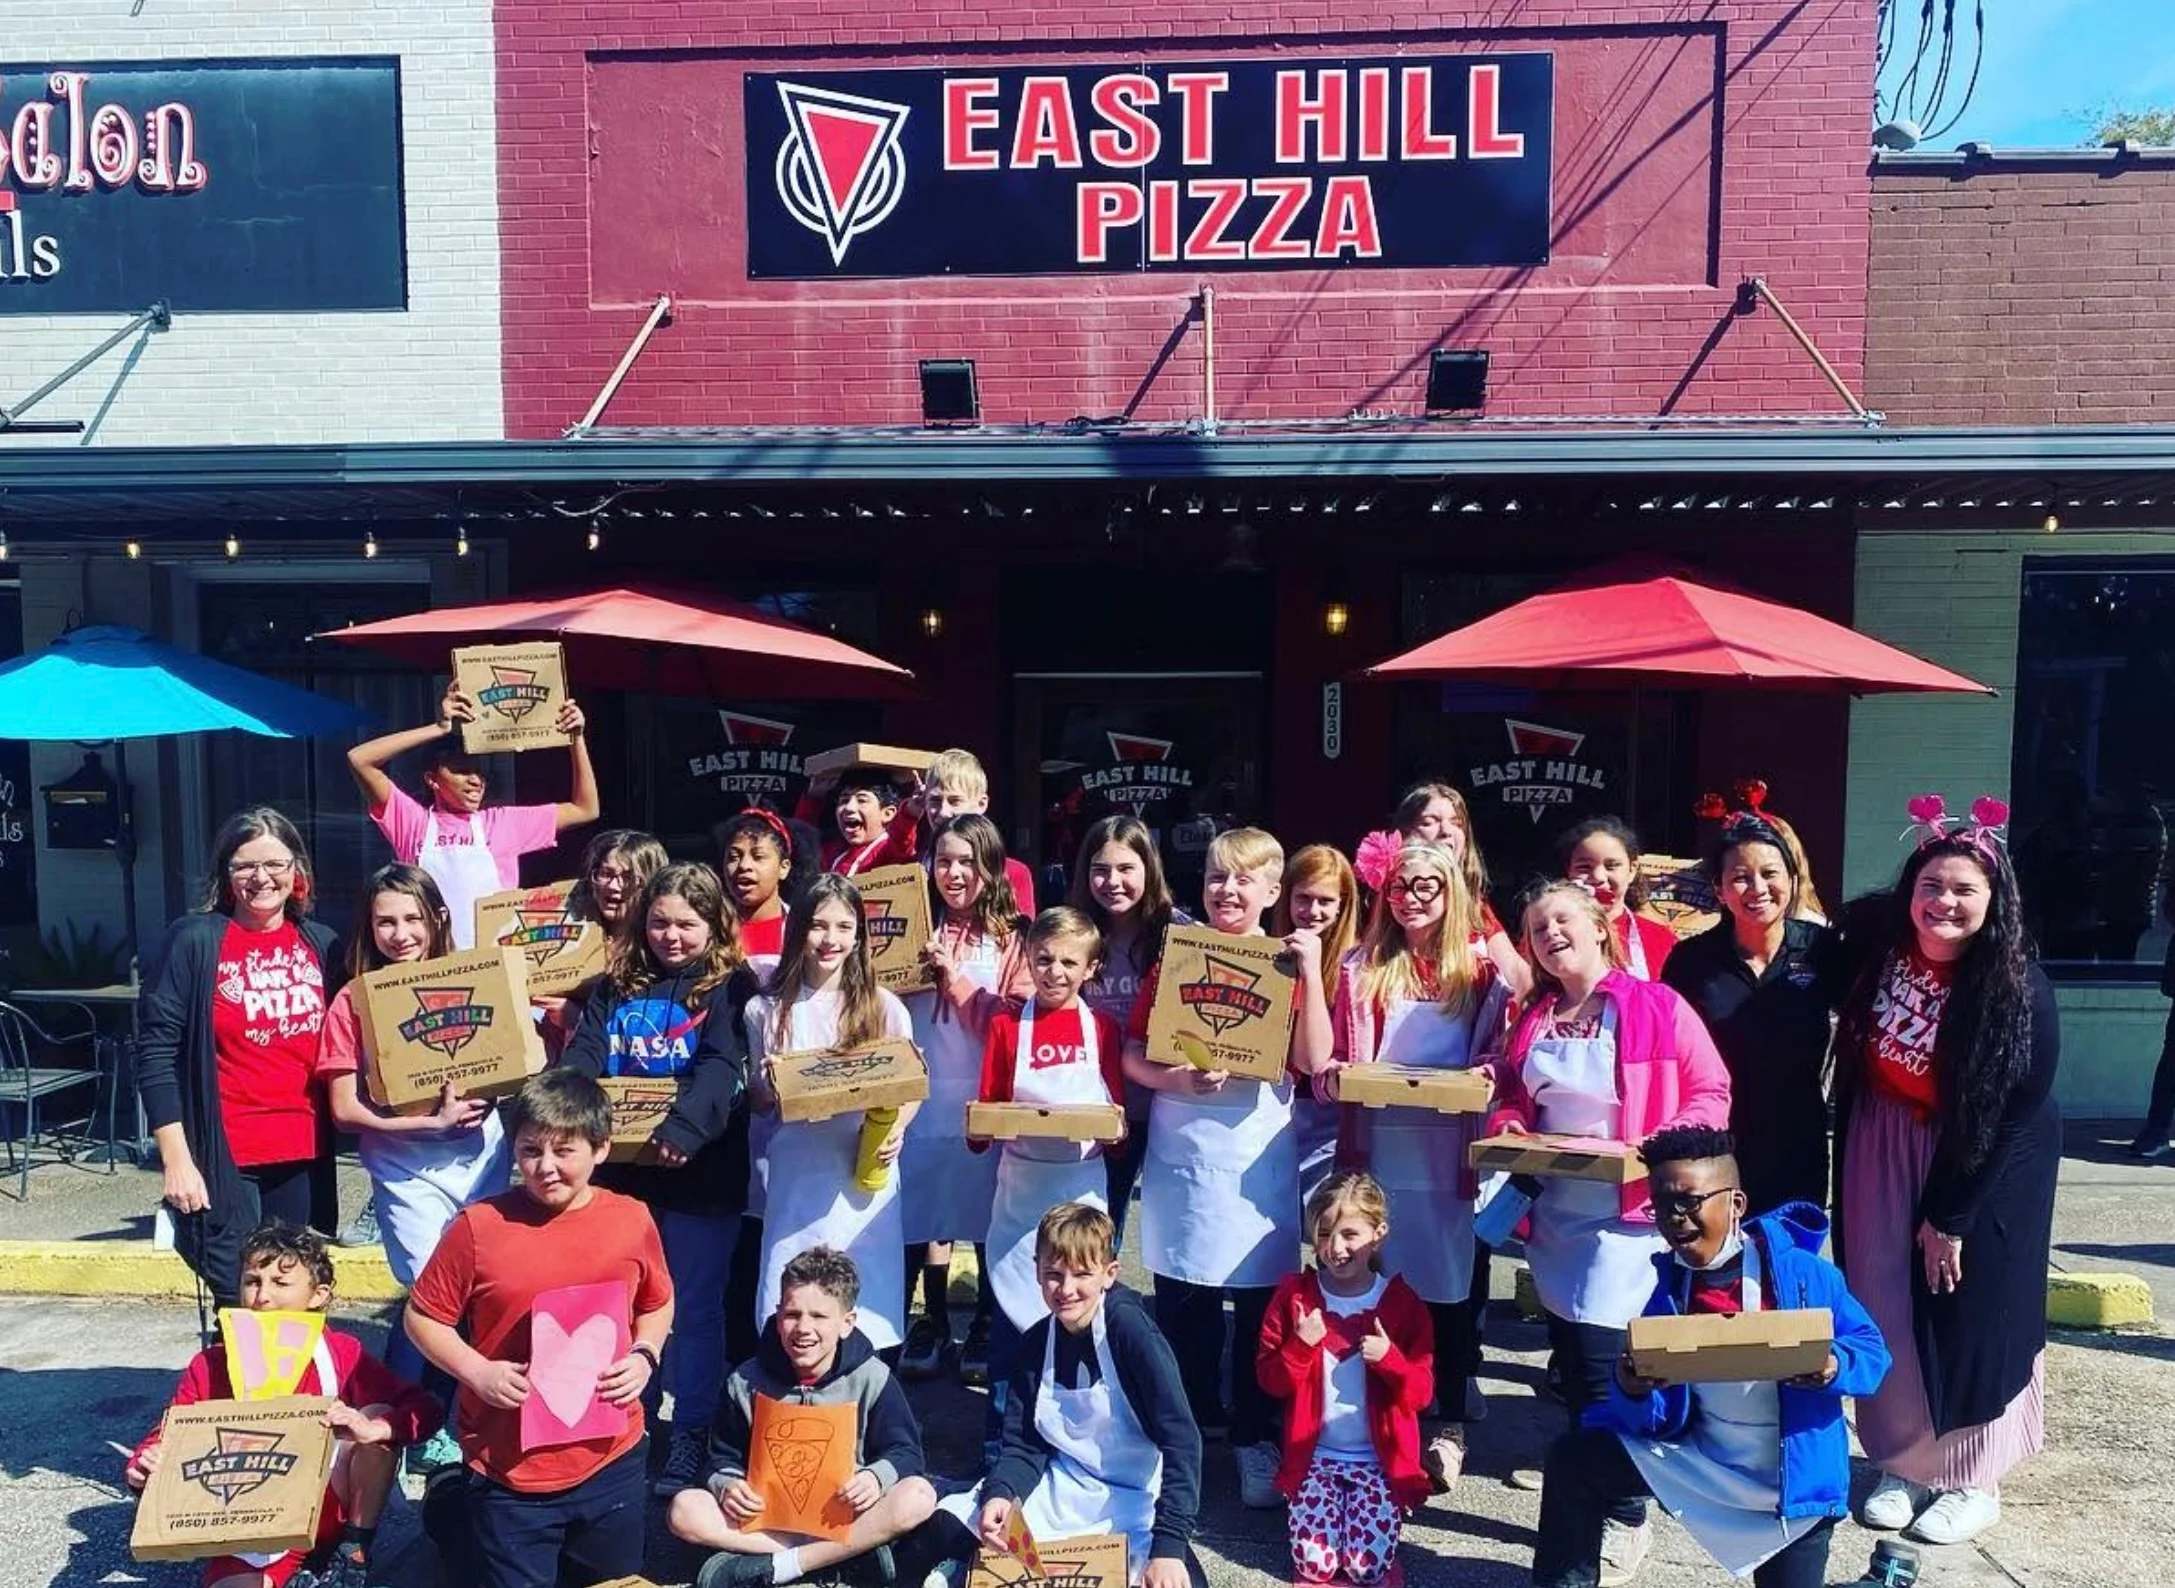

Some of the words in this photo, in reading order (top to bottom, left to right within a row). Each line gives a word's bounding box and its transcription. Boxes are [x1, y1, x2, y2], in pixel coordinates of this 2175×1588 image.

[943, 71, 1228, 171] EAST
[1276, 65, 1525, 163] HILL
[0, 72, 208, 191] alon
[1076, 175, 1383, 264] PIZZA
[516, 687, 546, 699] HILL
[1327, 686, 1338, 751] 2030
[689, 751, 750, 777] EAST
[760, 751, 804, 772] HIL
[1470, 760, 1536, 787] EAST
[1546, 760, 1606, 789] HILL
[727, 776, 784, 791] PIZZA
[1081, 766, 1135, 791] EAST
[1143, 766, 1193, 786] HILL
[1112, 787, 1164, 801] PIZZA
[1507, 788, 1569, 803] PIZZA
[1648, 891, 1675, 900] AST
[869, 920, 905, 935] HILL
[373, 959, 500, 990] WWW.EASTHILLPIZZA.COM
[243, 983, 323, 1022] PIZZA
[1183, 986, 1224, 1001] EAST
[1228, 989, 1267, 1014] HILL
[403, 1014, 444, 1037] EAST
[449, 1008, 491, 1024] HILL
[1872, 987, 1939, 1053] PIZZA
[609, 1033, 691, 1059] NASA
[1212, 1047, 1255, 1063] 57-9977
[414, 1074, 443, 1089] (850)
[174, 1408, 326, 1426] WWW.EASTHILLPIZZA.COM
[185, 1456, 238, 1478] EAST
[243, 1455, 290, 1472] HILL
[169, 1517, 207, 1531] (850)
[210, 1513, 277, 1527] 857-9977
[1053, 1578, 1097, 1588] HILL
